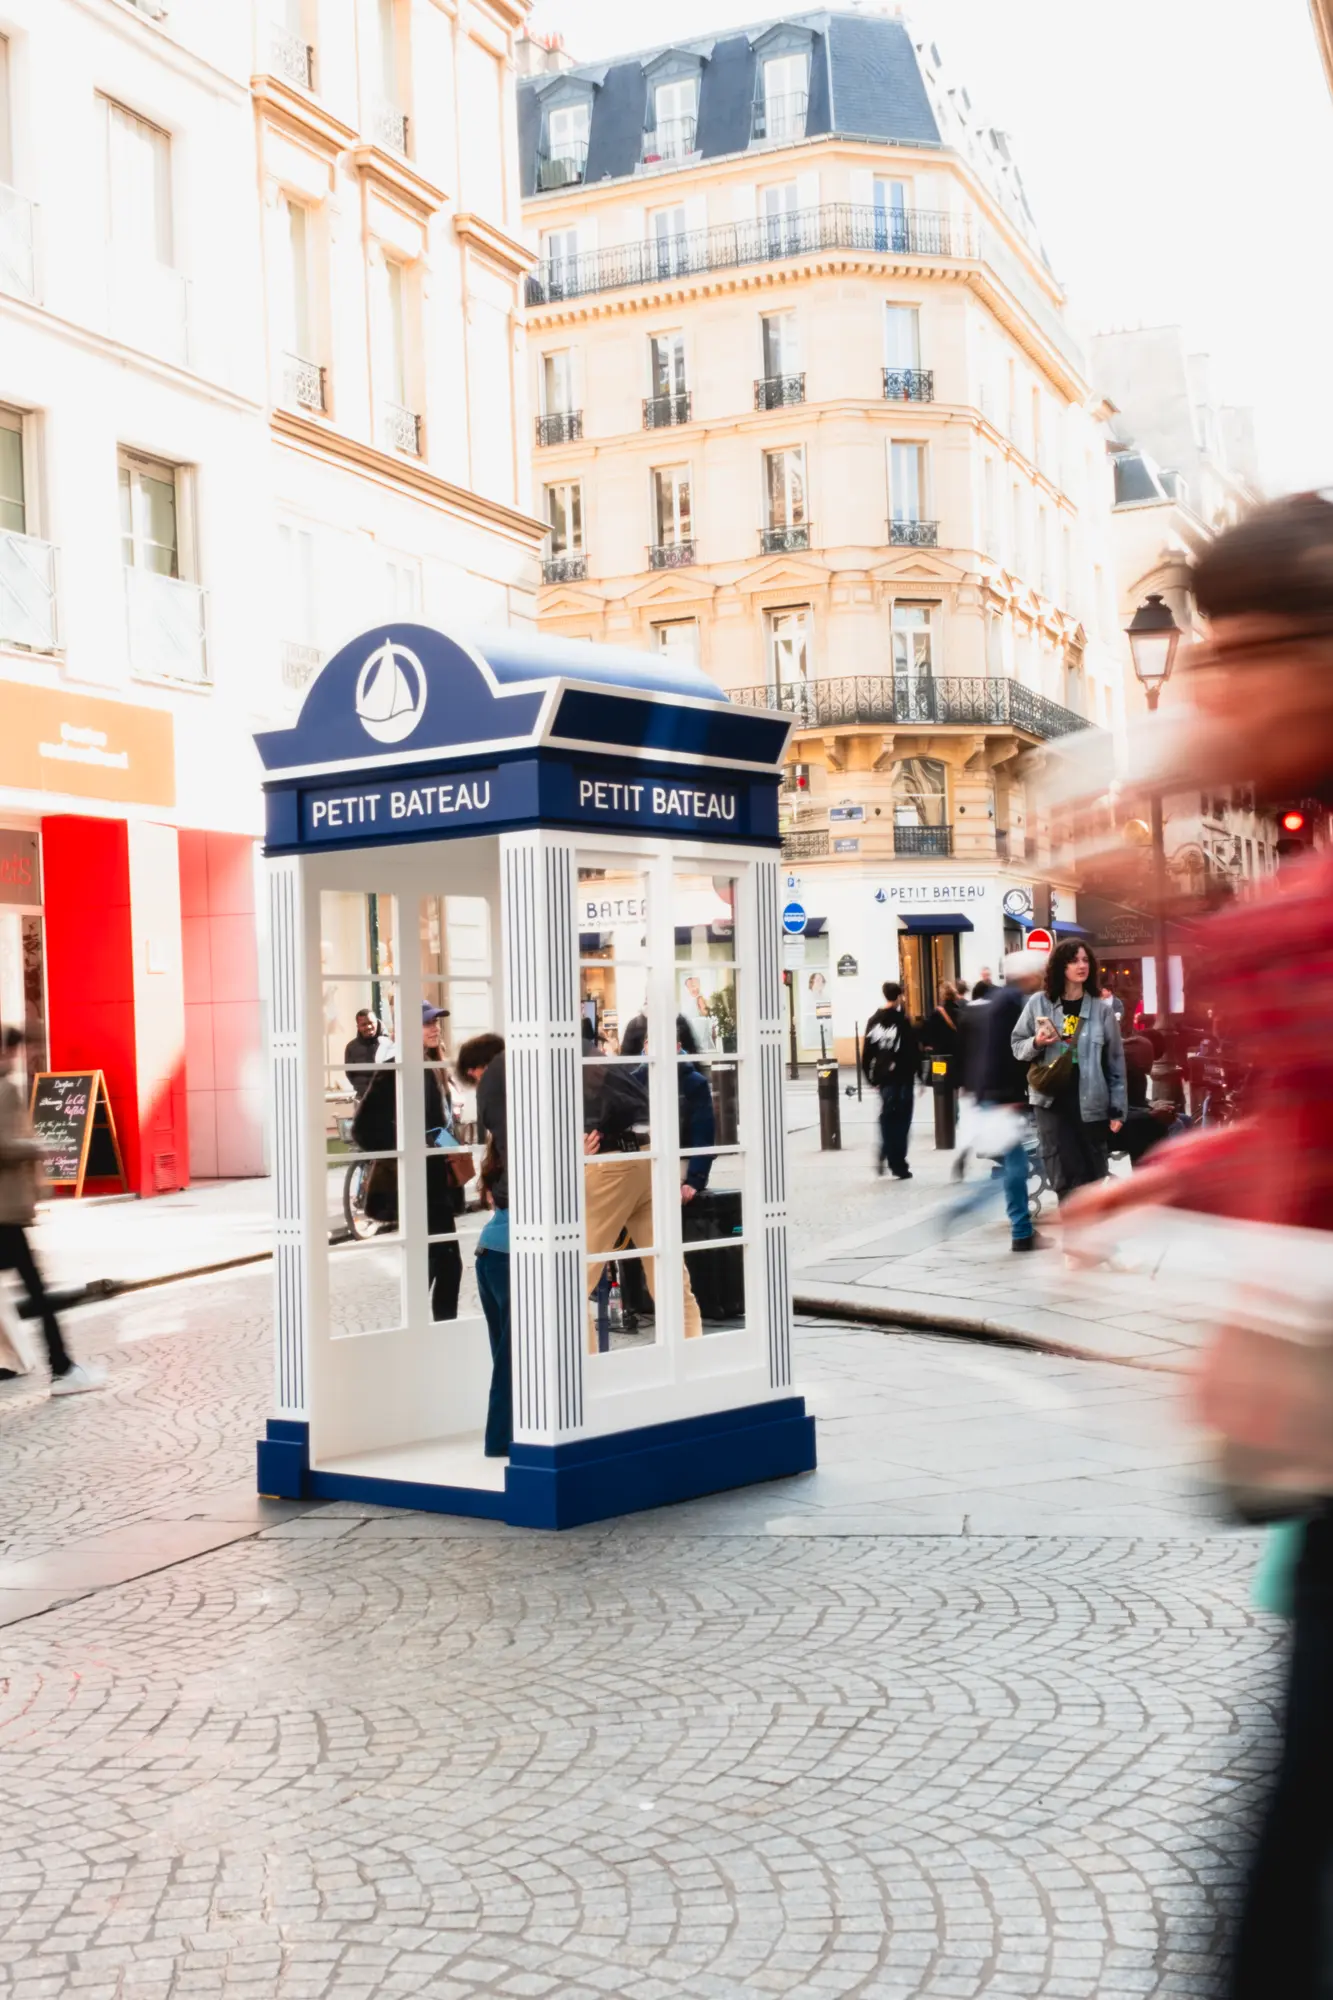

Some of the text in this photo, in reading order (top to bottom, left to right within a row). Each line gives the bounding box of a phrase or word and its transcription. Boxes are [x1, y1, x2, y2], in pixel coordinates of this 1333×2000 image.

[313, 780, 491, 828] PETIT BATEAU
[579, 780, 736, 821] PETIT BATEAU
[890, 886, 985, 899] PETIT BATEAU
